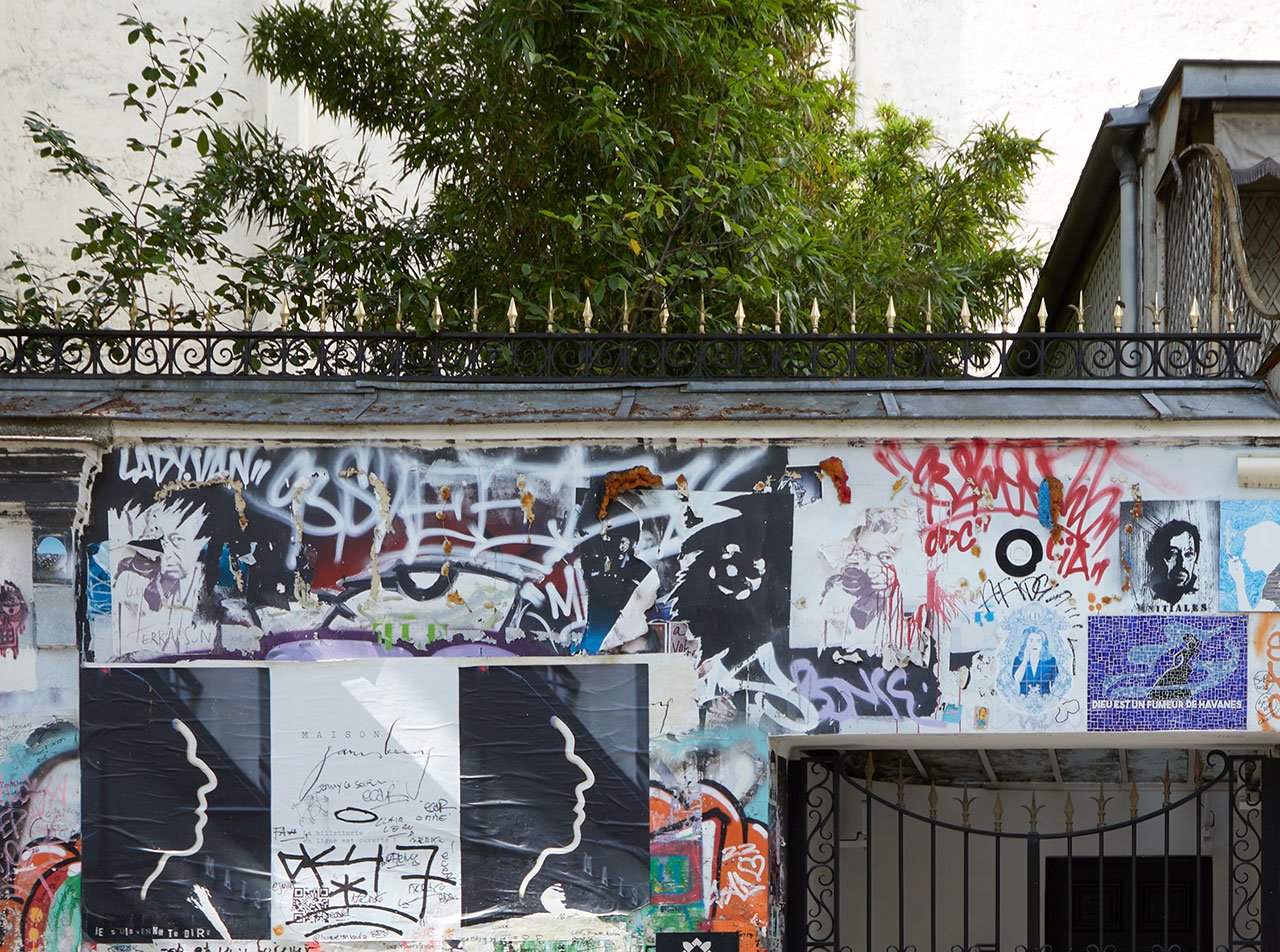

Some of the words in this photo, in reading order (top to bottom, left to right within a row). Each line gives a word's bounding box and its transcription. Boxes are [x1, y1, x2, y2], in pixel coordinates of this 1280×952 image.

[1092, 700, 1113, 709] DIEU
[1113, 700, 1132, 709] EST
[1132, 700, 1145, 709] UN
[1147, 700, 1184, 709] FUMEUR
[1185, 700, 1197, 709] DE
[1199, 700, 1242, 709] HAVANES
[301, 730, 382, 740] MAISON
[320, 837, 338, 845] ligne
